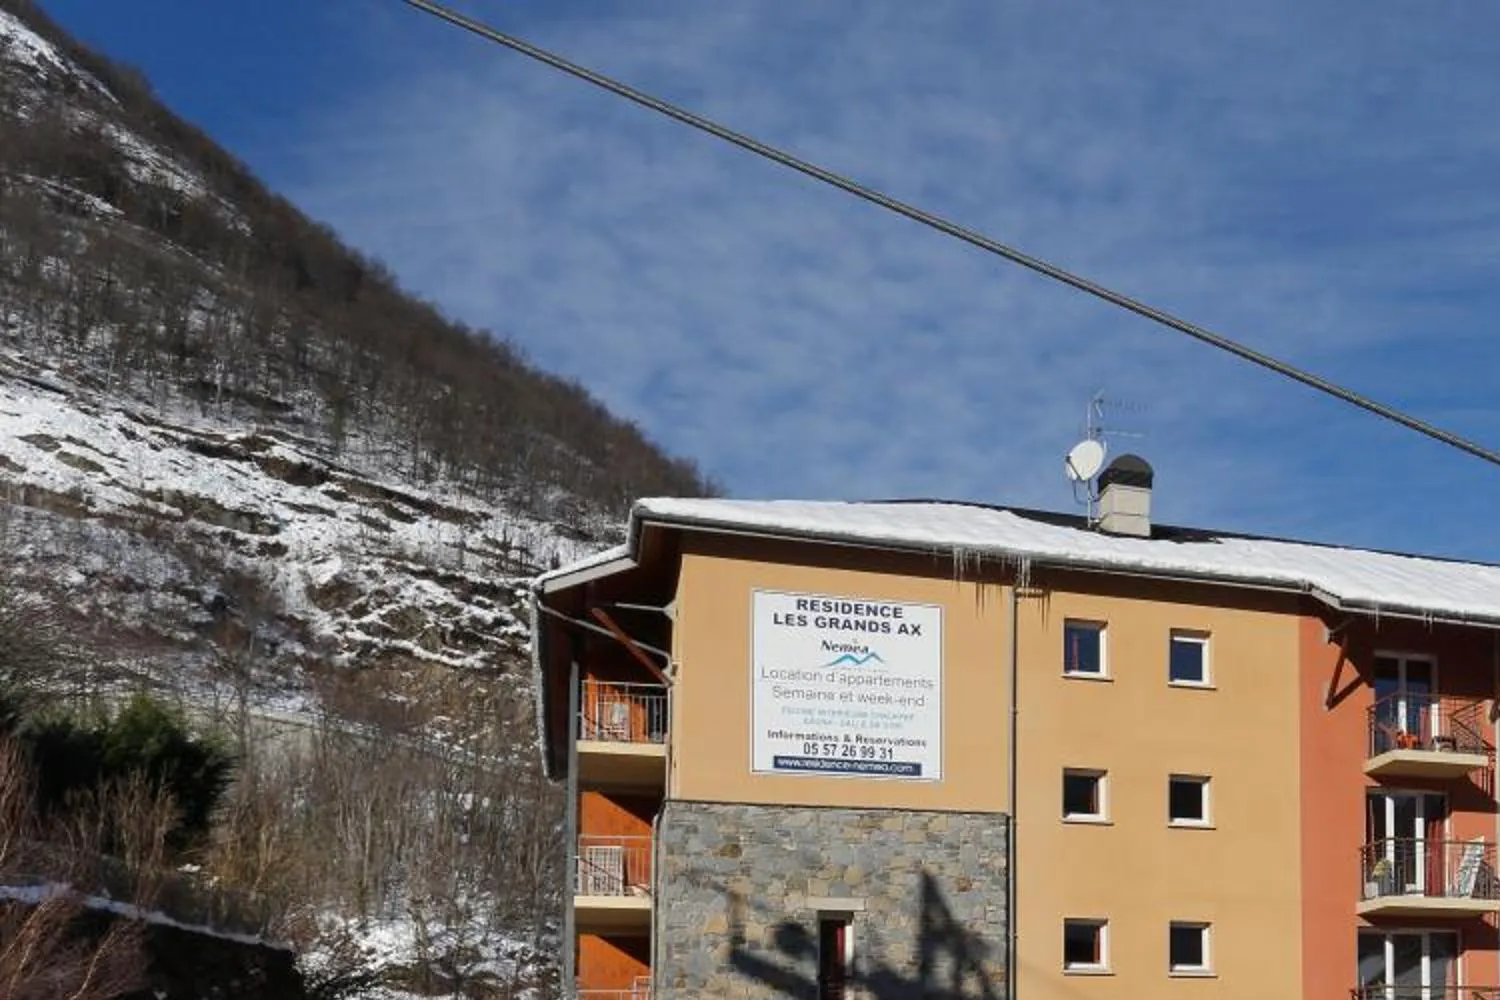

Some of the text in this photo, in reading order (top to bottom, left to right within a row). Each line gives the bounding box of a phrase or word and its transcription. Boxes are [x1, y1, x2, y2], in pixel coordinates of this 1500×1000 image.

[796, 599, 904, 619] RESIDENCE
[773, 612, 922, 637] LES GRANDS AX
[761, 667, 823, 682] Location
[772, 686, 926, 707] Semaine et week-end
[767, 729, 840, 743] Informations
[803, 741, 893, 761] 05 57 26 99 31
